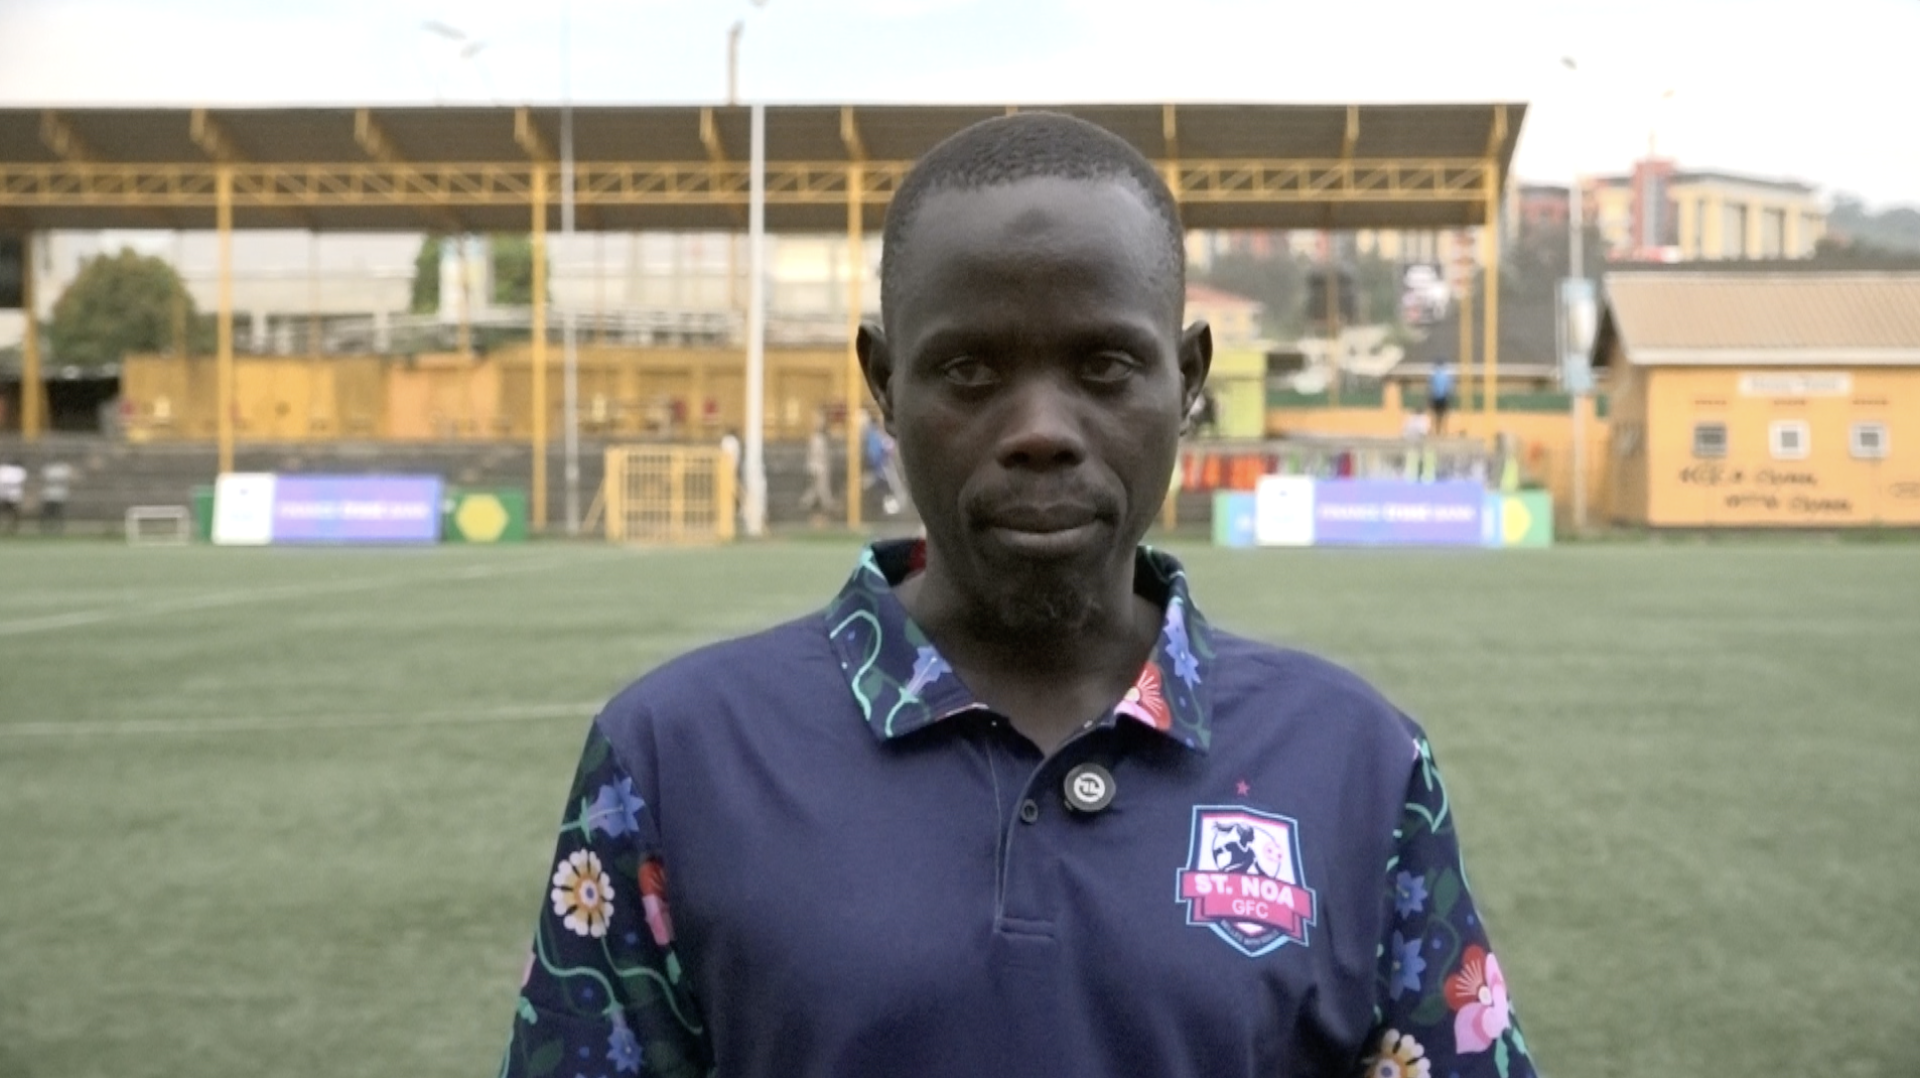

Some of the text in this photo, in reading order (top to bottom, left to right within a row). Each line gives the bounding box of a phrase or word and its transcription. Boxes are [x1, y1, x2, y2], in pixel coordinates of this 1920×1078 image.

[1194, 873, 1295, 909] ST. NOA
[1232, 899, 1269, 919] GFC
